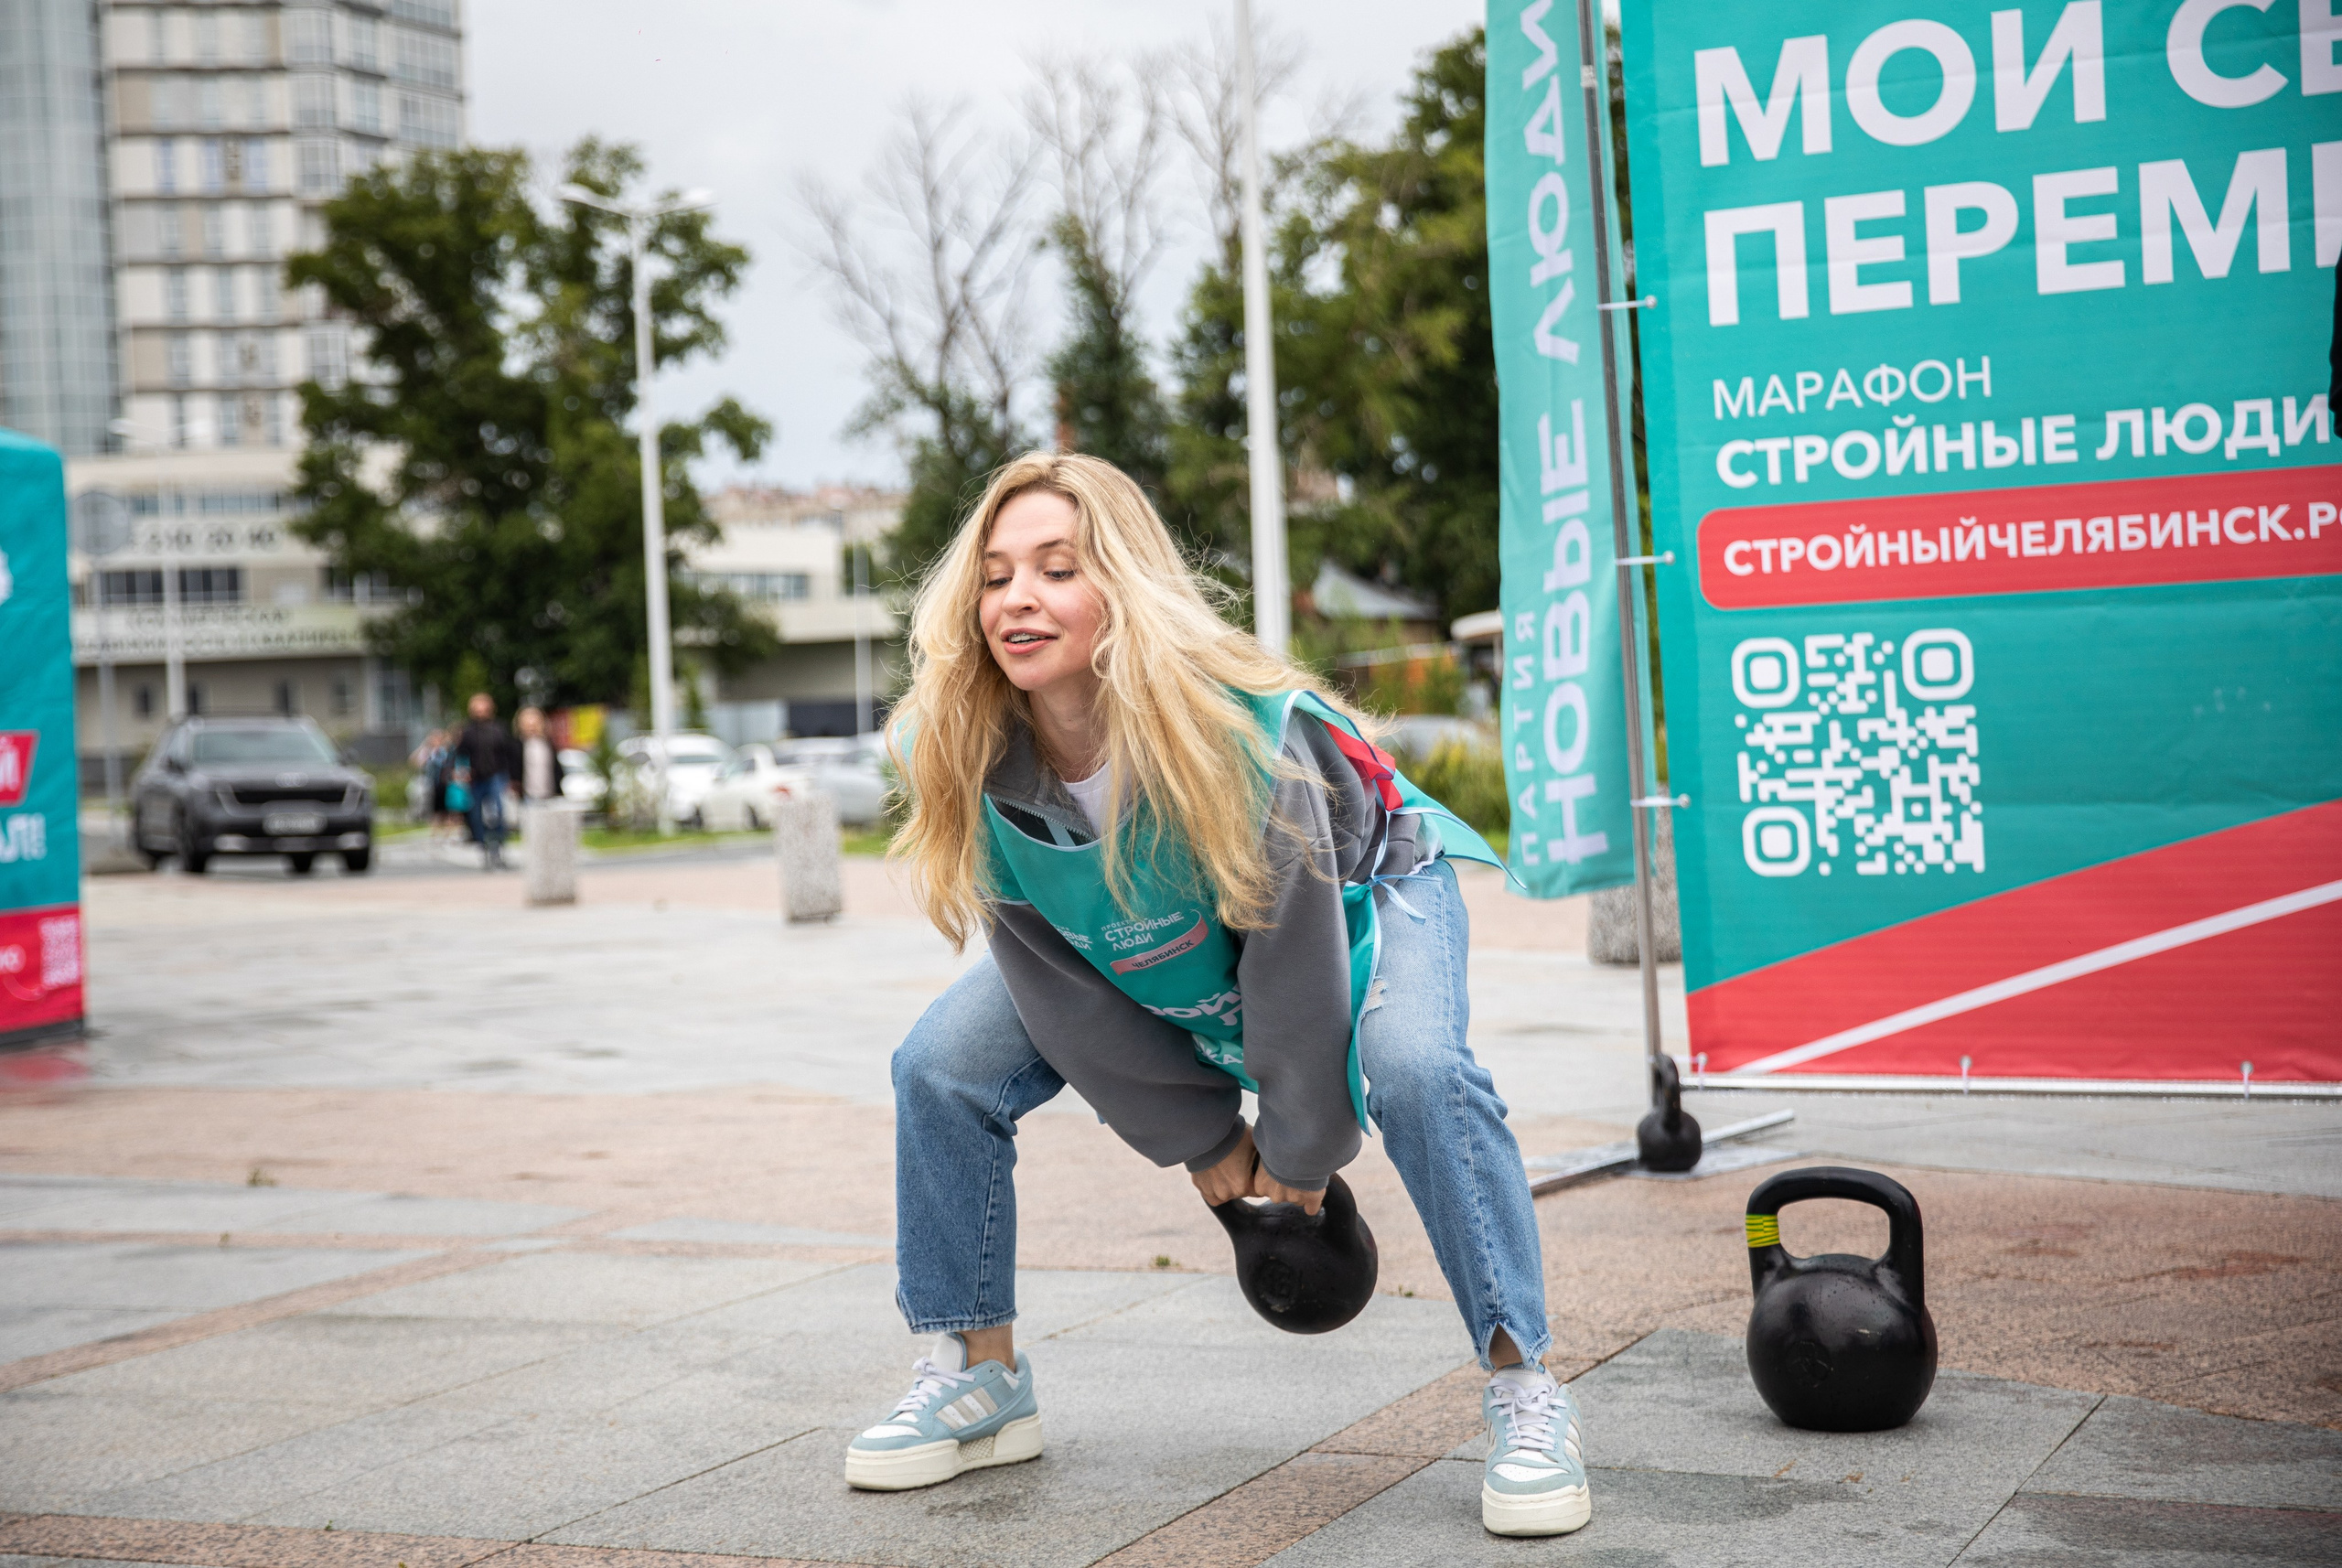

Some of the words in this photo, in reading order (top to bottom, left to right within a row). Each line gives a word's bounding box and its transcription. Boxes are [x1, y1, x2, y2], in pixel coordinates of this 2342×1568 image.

[1712, 355, 1993, 420] МАРАФОН
[1716, 414, 2078, 489] СТРОЙНЫЕ
[2096, 393, 2330, 460] ЛЮДИ
[1723, 501, 2342, 577] СТРОЙНЫЙЧЕЛЯБИНСК.Р
[1538, 398, 1610, 866] НОВЫЕ
[1513, 611, 1541, 866] ПАРТИЯ
[1104, 911, 1185, 941] СТРОЙНЫЕ
[1112, 932, 1155, 951] ЛЮДИ
[1132, 940, 1195, 969] ЧЕЛЯБИНСК
